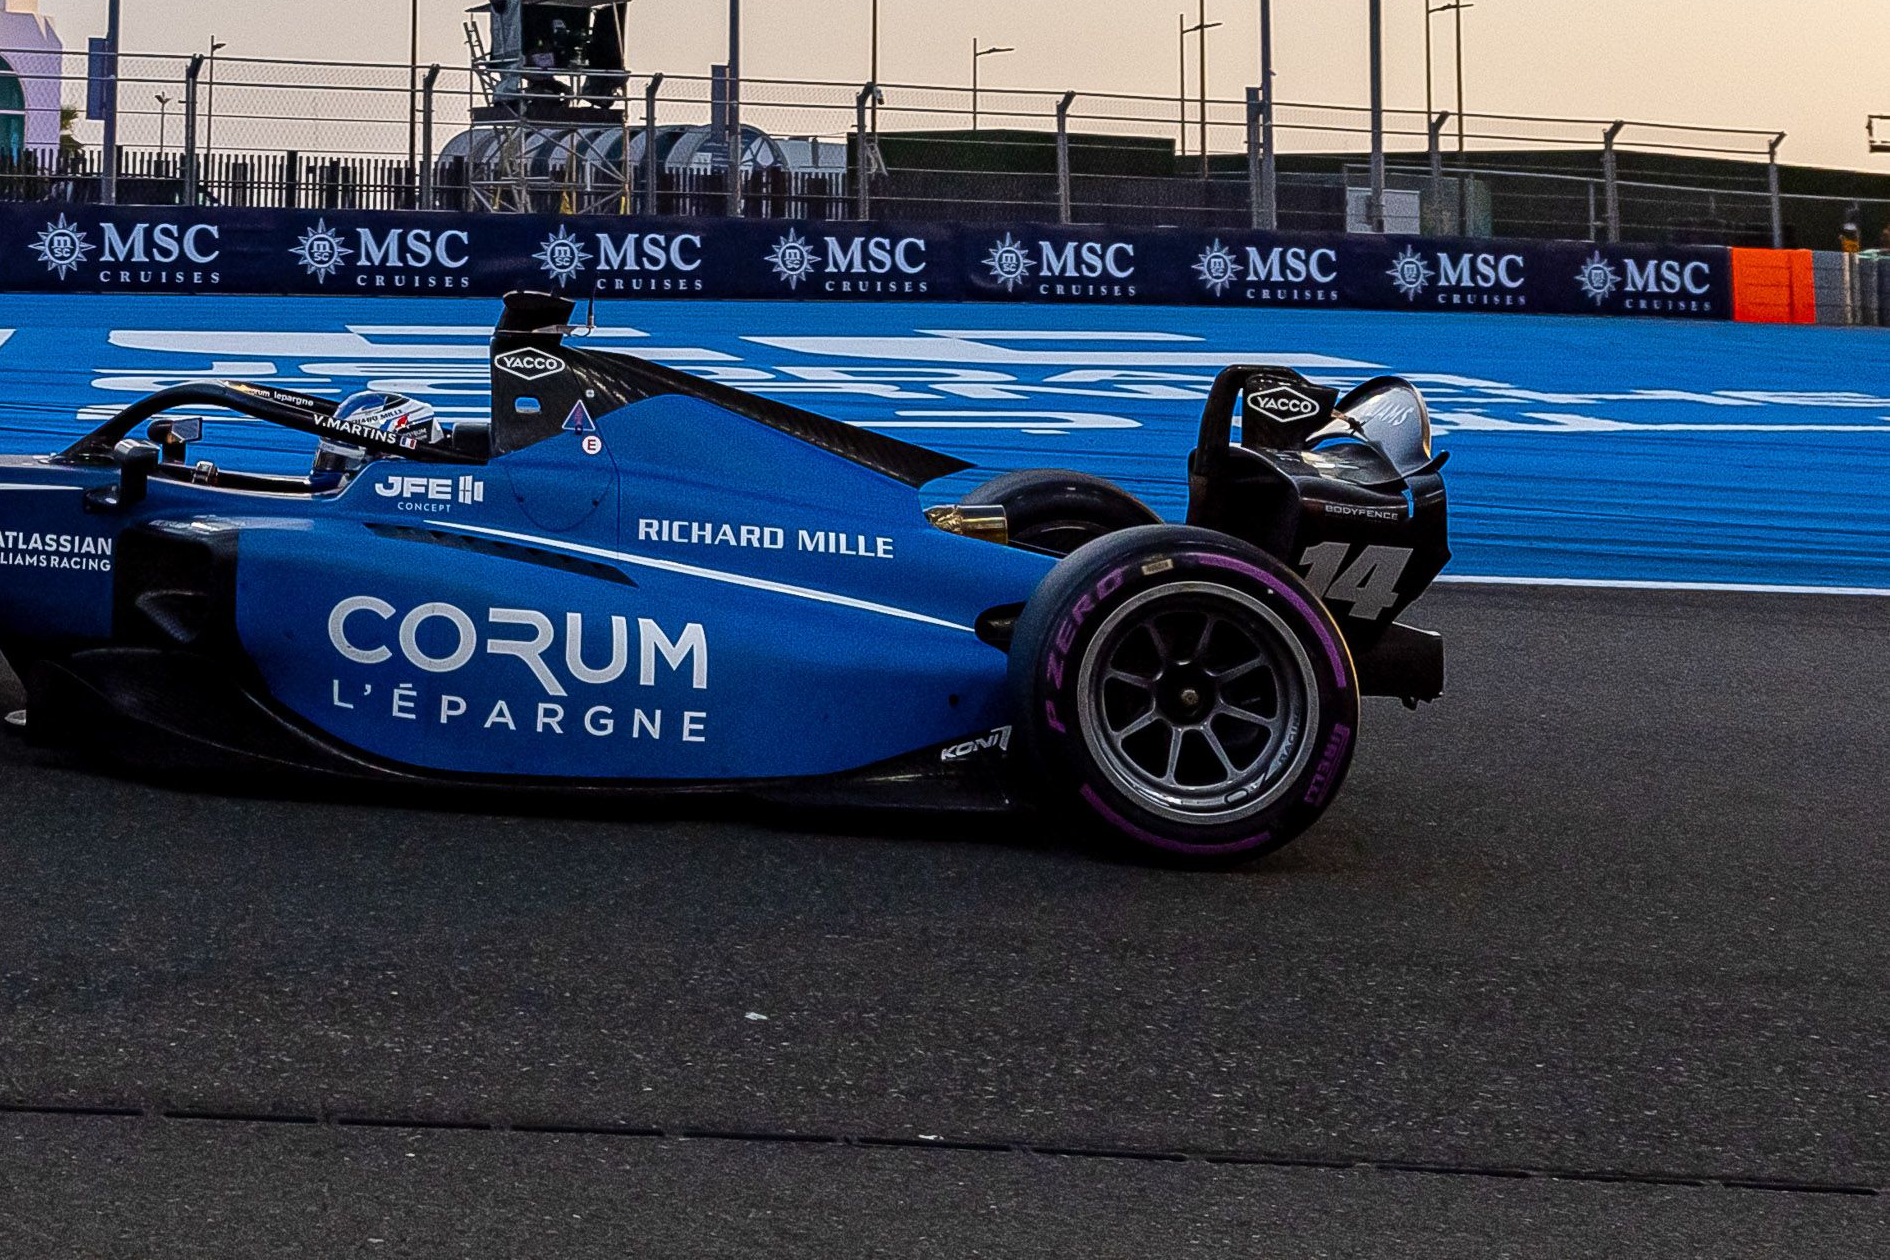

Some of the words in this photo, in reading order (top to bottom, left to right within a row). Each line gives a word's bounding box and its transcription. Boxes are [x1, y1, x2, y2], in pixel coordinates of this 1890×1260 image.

[99, 222, 220, 264] MSC
[355, 227, 469, 269] MSC
[595, 233, 702, 271] MSC
[823, 236, 926, 274] MSC
[1038, 240, 1135, 279] MSC
[1245, 246, 1337, 283] MSC
[1436, 252, 1525, 288] MSC
[99, 270, 220, 284] CRUISES
[356, 274, 469, 288] CRUISES
[596, 278, 703, 291] CRUISES
[824, 280, 928, 293] CRUISES
[1623, 258, 1710, 295] MSC
[1039, 284, 1136, 296] CRUISES
[1246, 288, 1338, 301] CRUISES
[1437, 293, 1525, 305] CRUISES
[1624, 298, 1712, 313] CRUISES
[503, 356, 558, 370] YACCO
[1257, 396, 1313, 413] YACCO
[313, 414, 397, 444] V.MARTINS
[587, 439, 598, 451] E
[375, 475, 452, 501] JFE
[397, 501, 451, 513] CONCEPT
[1324, 504, 1399, 520] BODYFENCE
[638, 518, 784, 549] RICHARD
[798, 529, 894, 559] MILLE
[50, 555, 112, 572] RACING
[1298, 541, 1414, 621] 14
[1047, 565, 1126, 691] ZERO
[328, 594, 709, 697] CORUM
[333, 679, 708, 743] L'ÉPARGNE
